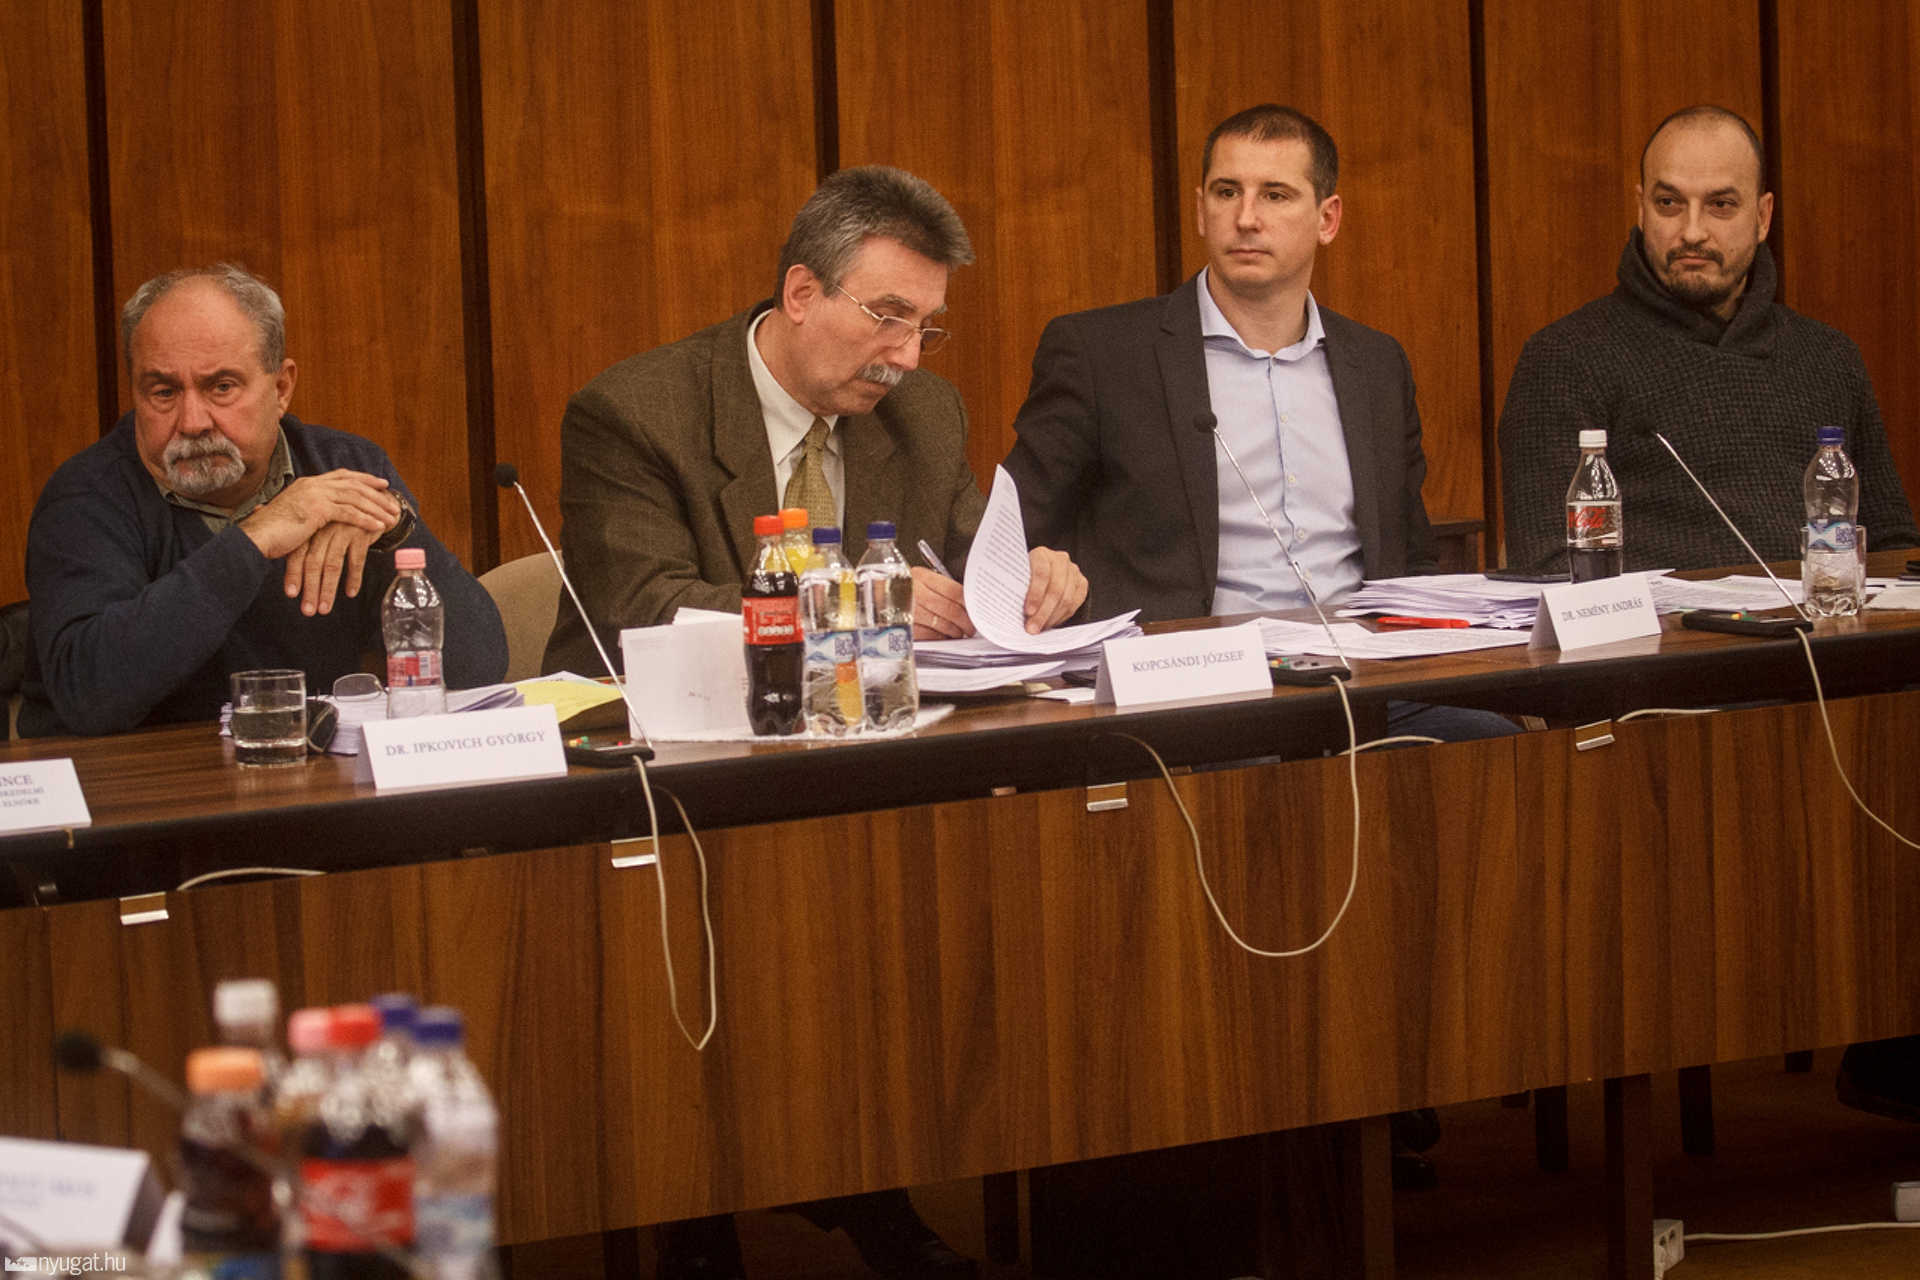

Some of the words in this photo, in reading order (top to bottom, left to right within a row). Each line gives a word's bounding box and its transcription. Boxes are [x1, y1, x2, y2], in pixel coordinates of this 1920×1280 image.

[1132, 653, 1201, 673] KOPCSÁNDI
[1202, 649, 1245, 668] JÓZSEF
[385, 743, 409, 757] DR.
[413, 735, 483, 754] IPKOVICH
